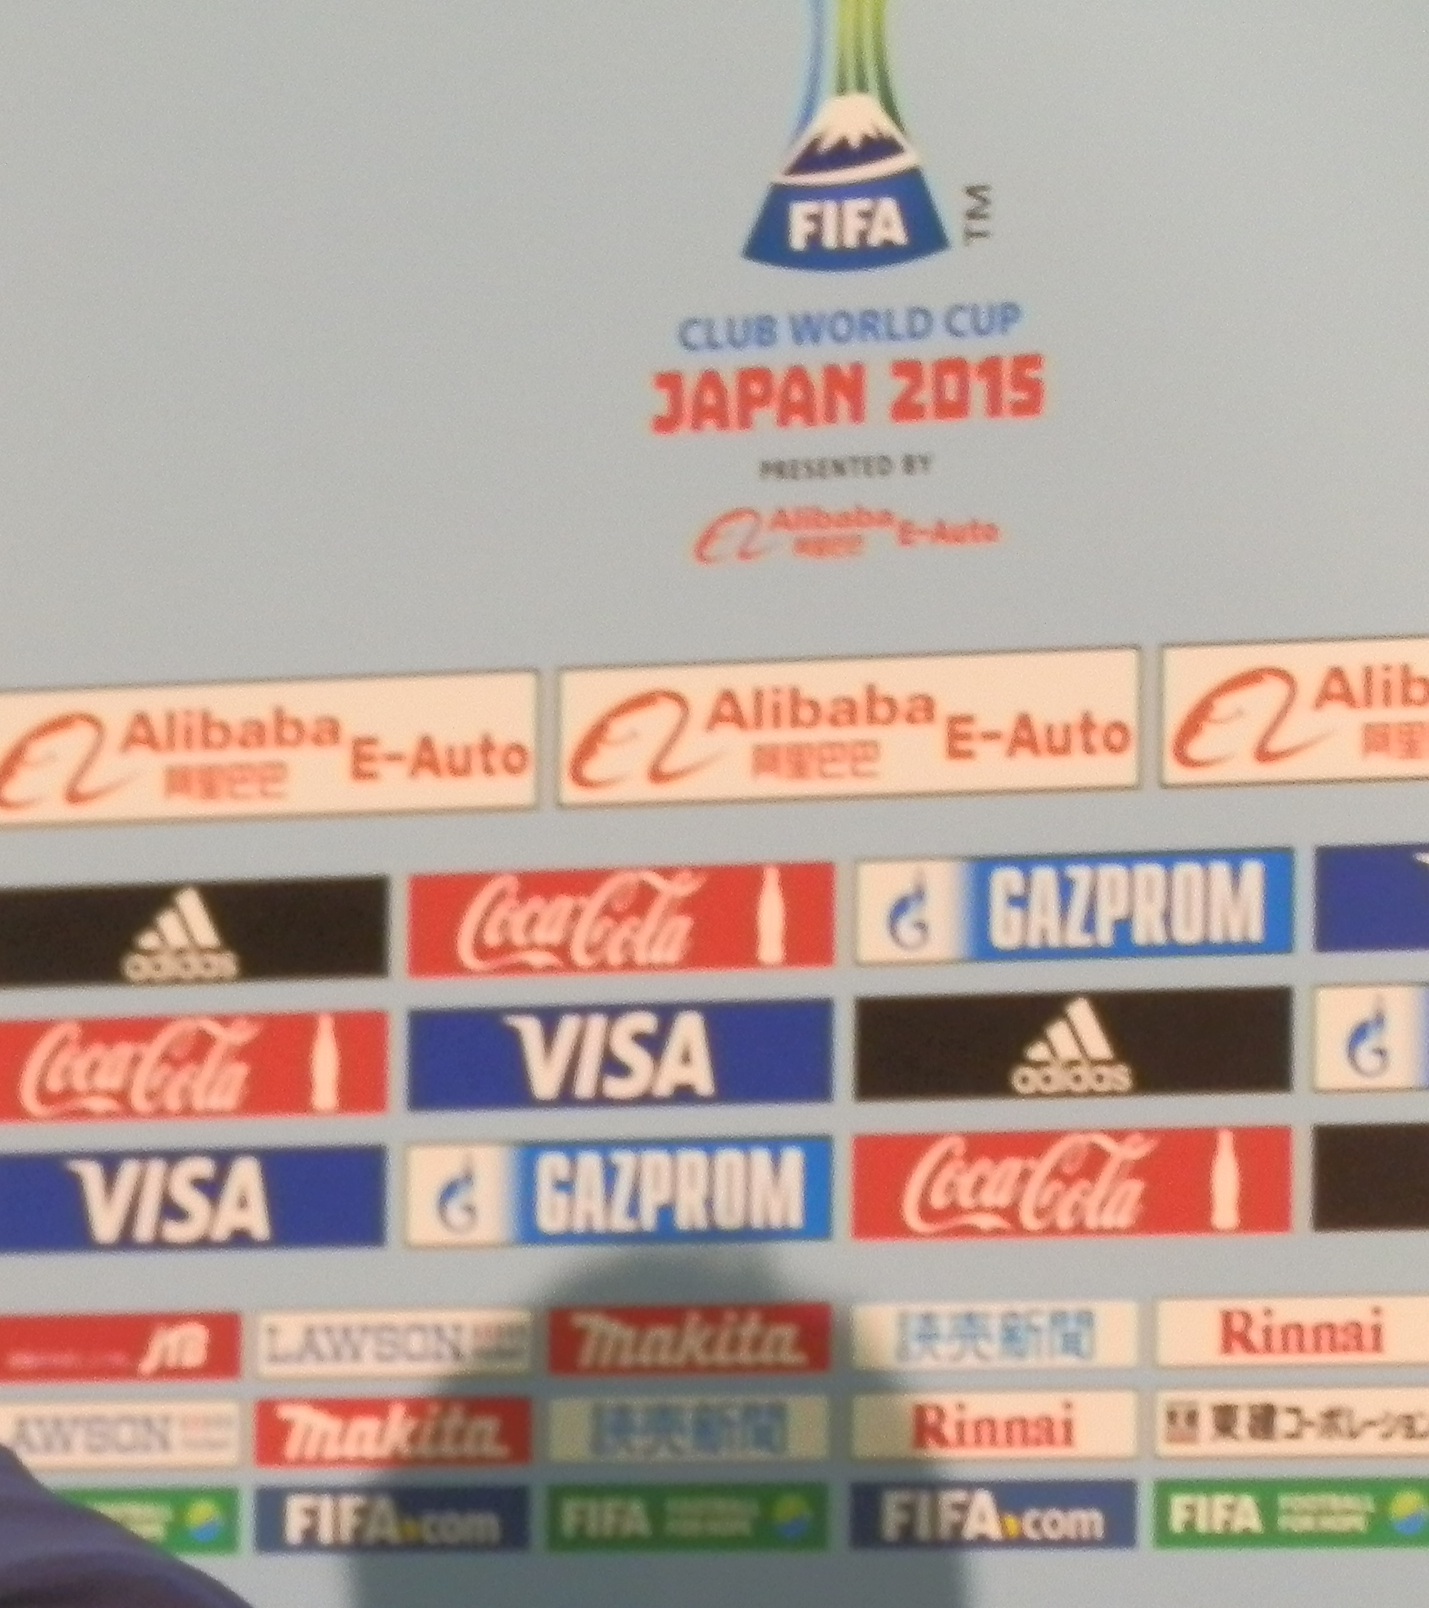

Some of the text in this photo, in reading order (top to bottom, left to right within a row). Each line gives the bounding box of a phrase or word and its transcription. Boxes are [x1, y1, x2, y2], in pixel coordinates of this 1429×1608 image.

[788, 197, 909, 252] FIFA
[963, 182, 993, 246] TM
[677, 300, 1023, 353] CLUB WORLD CUP
[649, 352, 1045, 435] JAPAN 2015
[759, 453, 934, 480] PRESENTED BY
[769, 504, 896, 532] Alibaba
[897, 518, 1001, 548] E-Auto
[1313, 663, 1429, 710] Alib
[119, 706, 531, 784] Alibaba E-Auto
[703, 684, 1132, 762] Alibaba E-Auto
[989, 860, 1265, 951] GAZPROM
[120, 949, 239, 984] adidas
[503, 1010, 717, 1101] VISA
[1009, 1059, 1134, 1095] adidas
[65, 1156, 272, 1245] VISA
[534, 1147, 805, 1234] GAZPROM
[266, 1324, 472, 1364] LAWSON
[894, 1309, 1096, 1365] 読売新聞
[1217, 1306, 1387, 1357] Rinnai
[911, 1402, 1076, 1451] Rinnai
[561, 1497, 652, 1538] FIFA
[881, 1488, 1107, 1543] FIFA.com
[1169, 1493, 1265, 1535] FIFA
